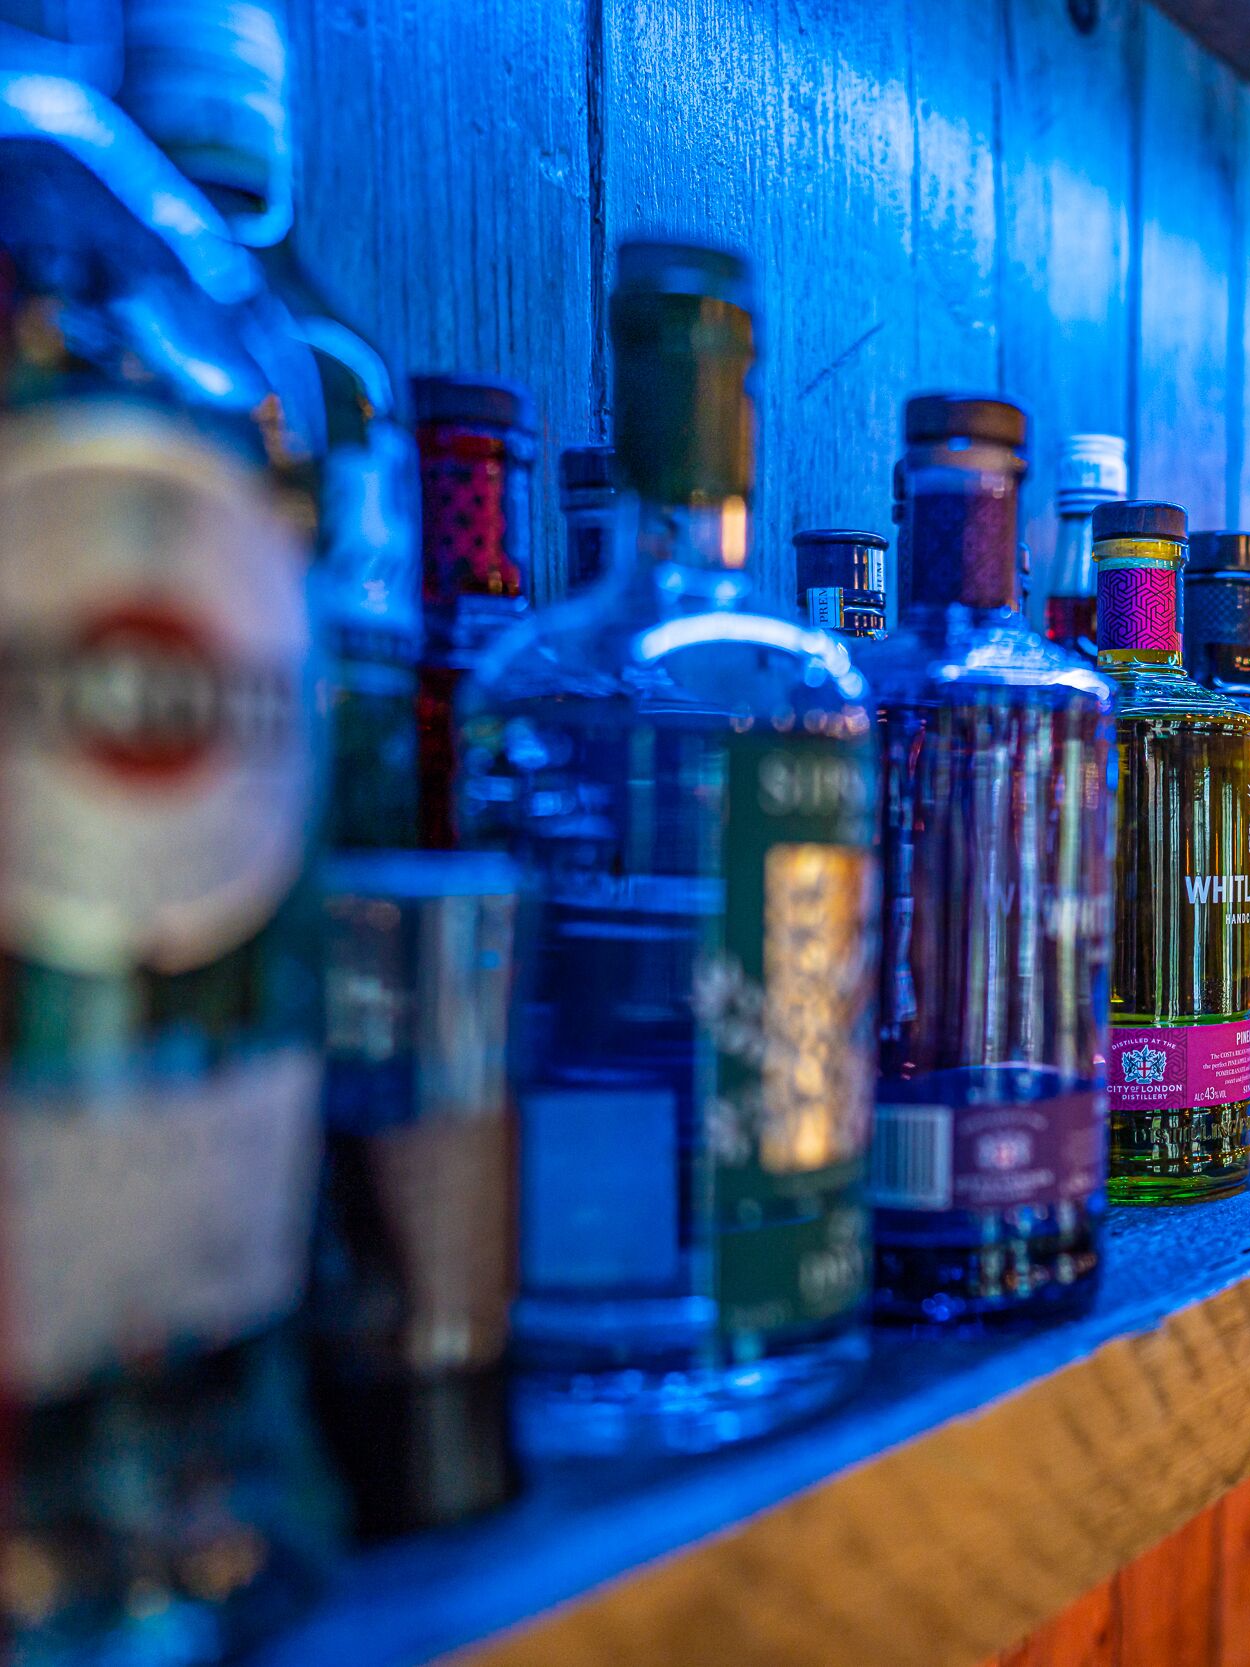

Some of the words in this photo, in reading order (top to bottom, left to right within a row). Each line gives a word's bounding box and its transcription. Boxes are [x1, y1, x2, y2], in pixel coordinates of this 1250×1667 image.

[1112, 1038, 1149, 1050] DISTILLED
[1163, 1040, 1177, 1050] THE
[1106, 1085, 1130, 1093] CITY
[1130, 1085, 1140, 1093] OF
[1141, 1084, 1183, 1093] LONDON
